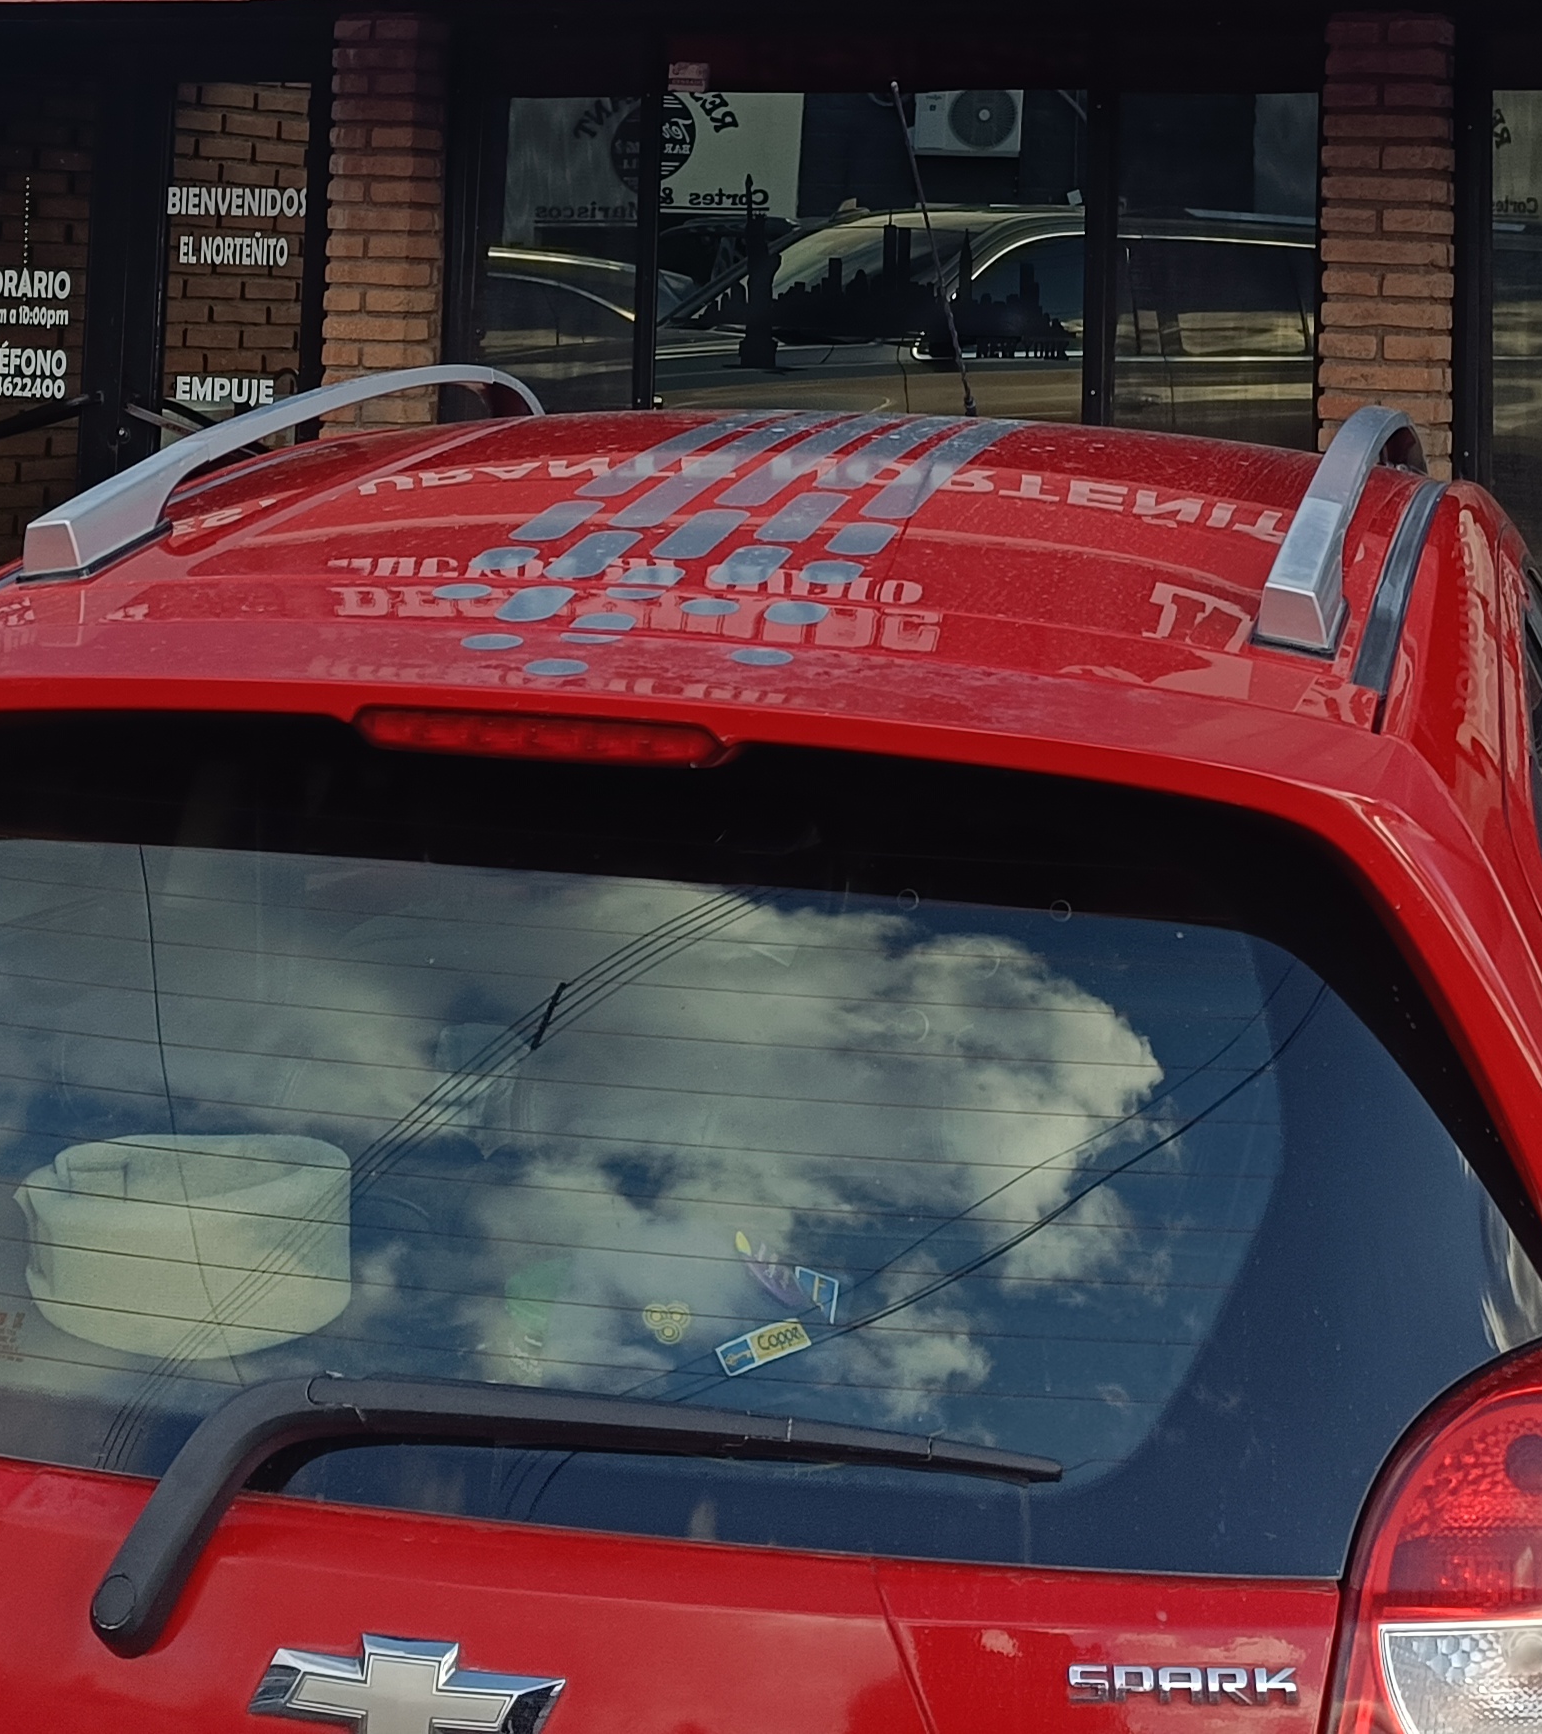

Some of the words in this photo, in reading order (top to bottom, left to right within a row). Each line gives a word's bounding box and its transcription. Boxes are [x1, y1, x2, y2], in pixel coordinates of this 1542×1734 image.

[167, 187, 307, 217] BIENVENIDOS
[179, 236, 196, 264] EL
[9, 309, 16, 324] a
[19, 305, 69, 329] 10:00pm
[175, 376, 274, 406] EMPUJE
[1068, 1663, 1301, 1704] SPARK
